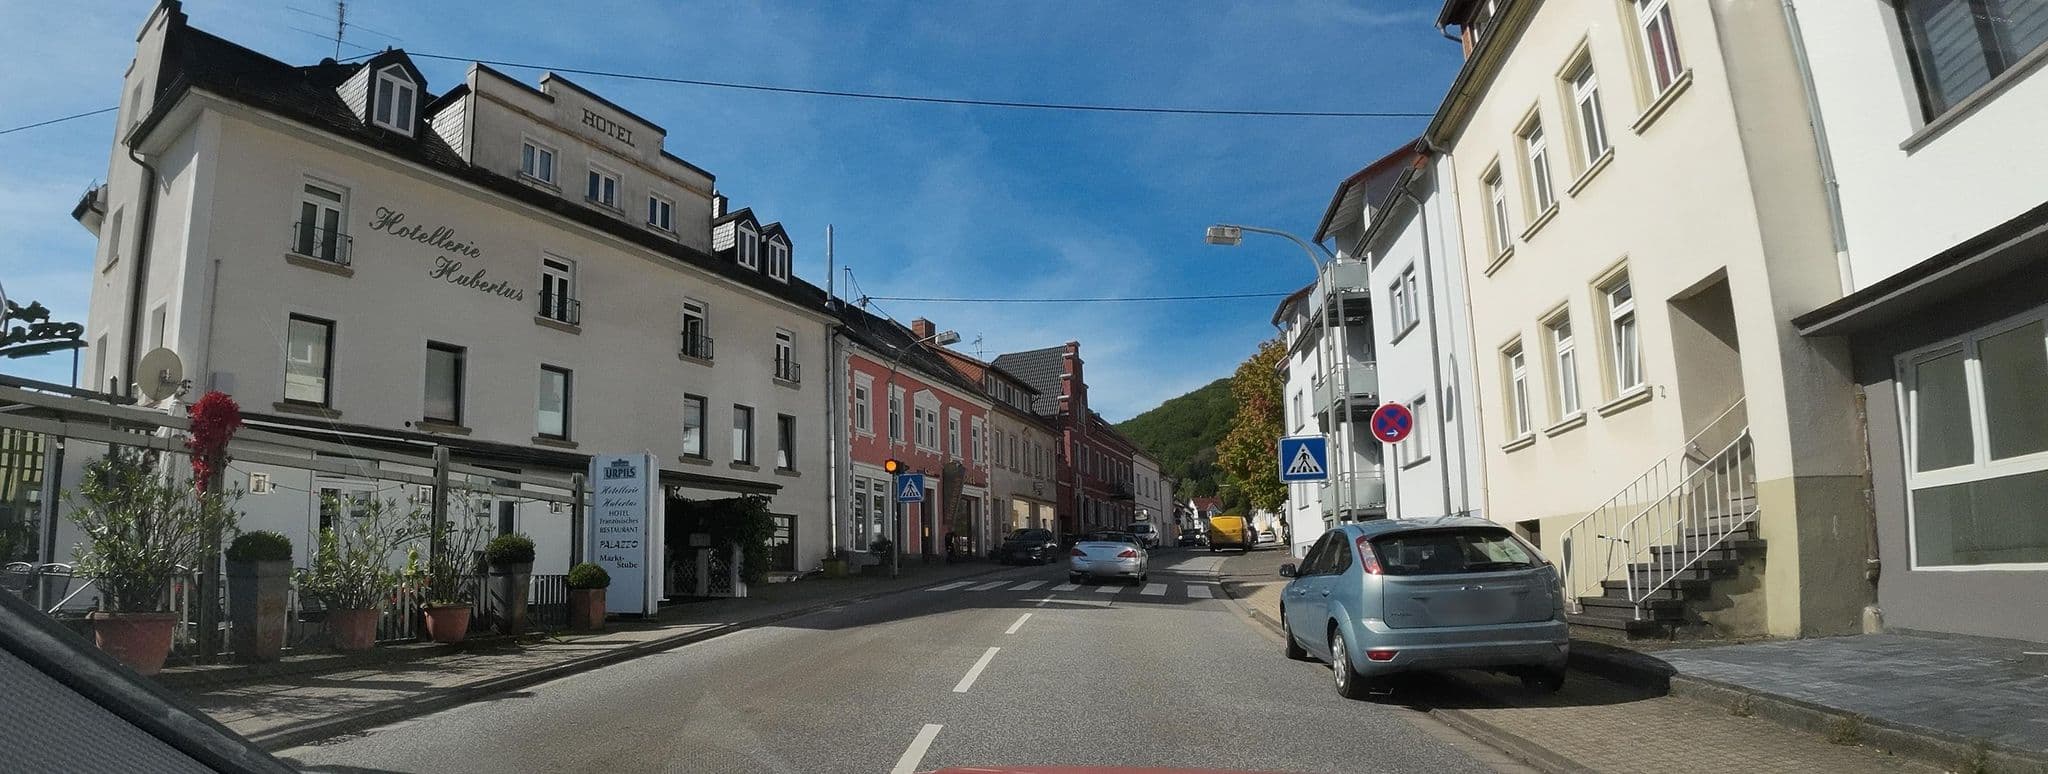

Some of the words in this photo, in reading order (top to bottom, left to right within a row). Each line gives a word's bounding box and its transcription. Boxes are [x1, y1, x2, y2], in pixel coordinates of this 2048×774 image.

[582, 107, 636, 148] HOTEL
[369, 206, 481, 259] Hotellerie
[429, 255, 524, 302] Hubertus
[599, 526, 639, 534] RESTAURANT
[599, 540, 639, 549] PALAZZO
[616, 561, 639, 569] Stube
